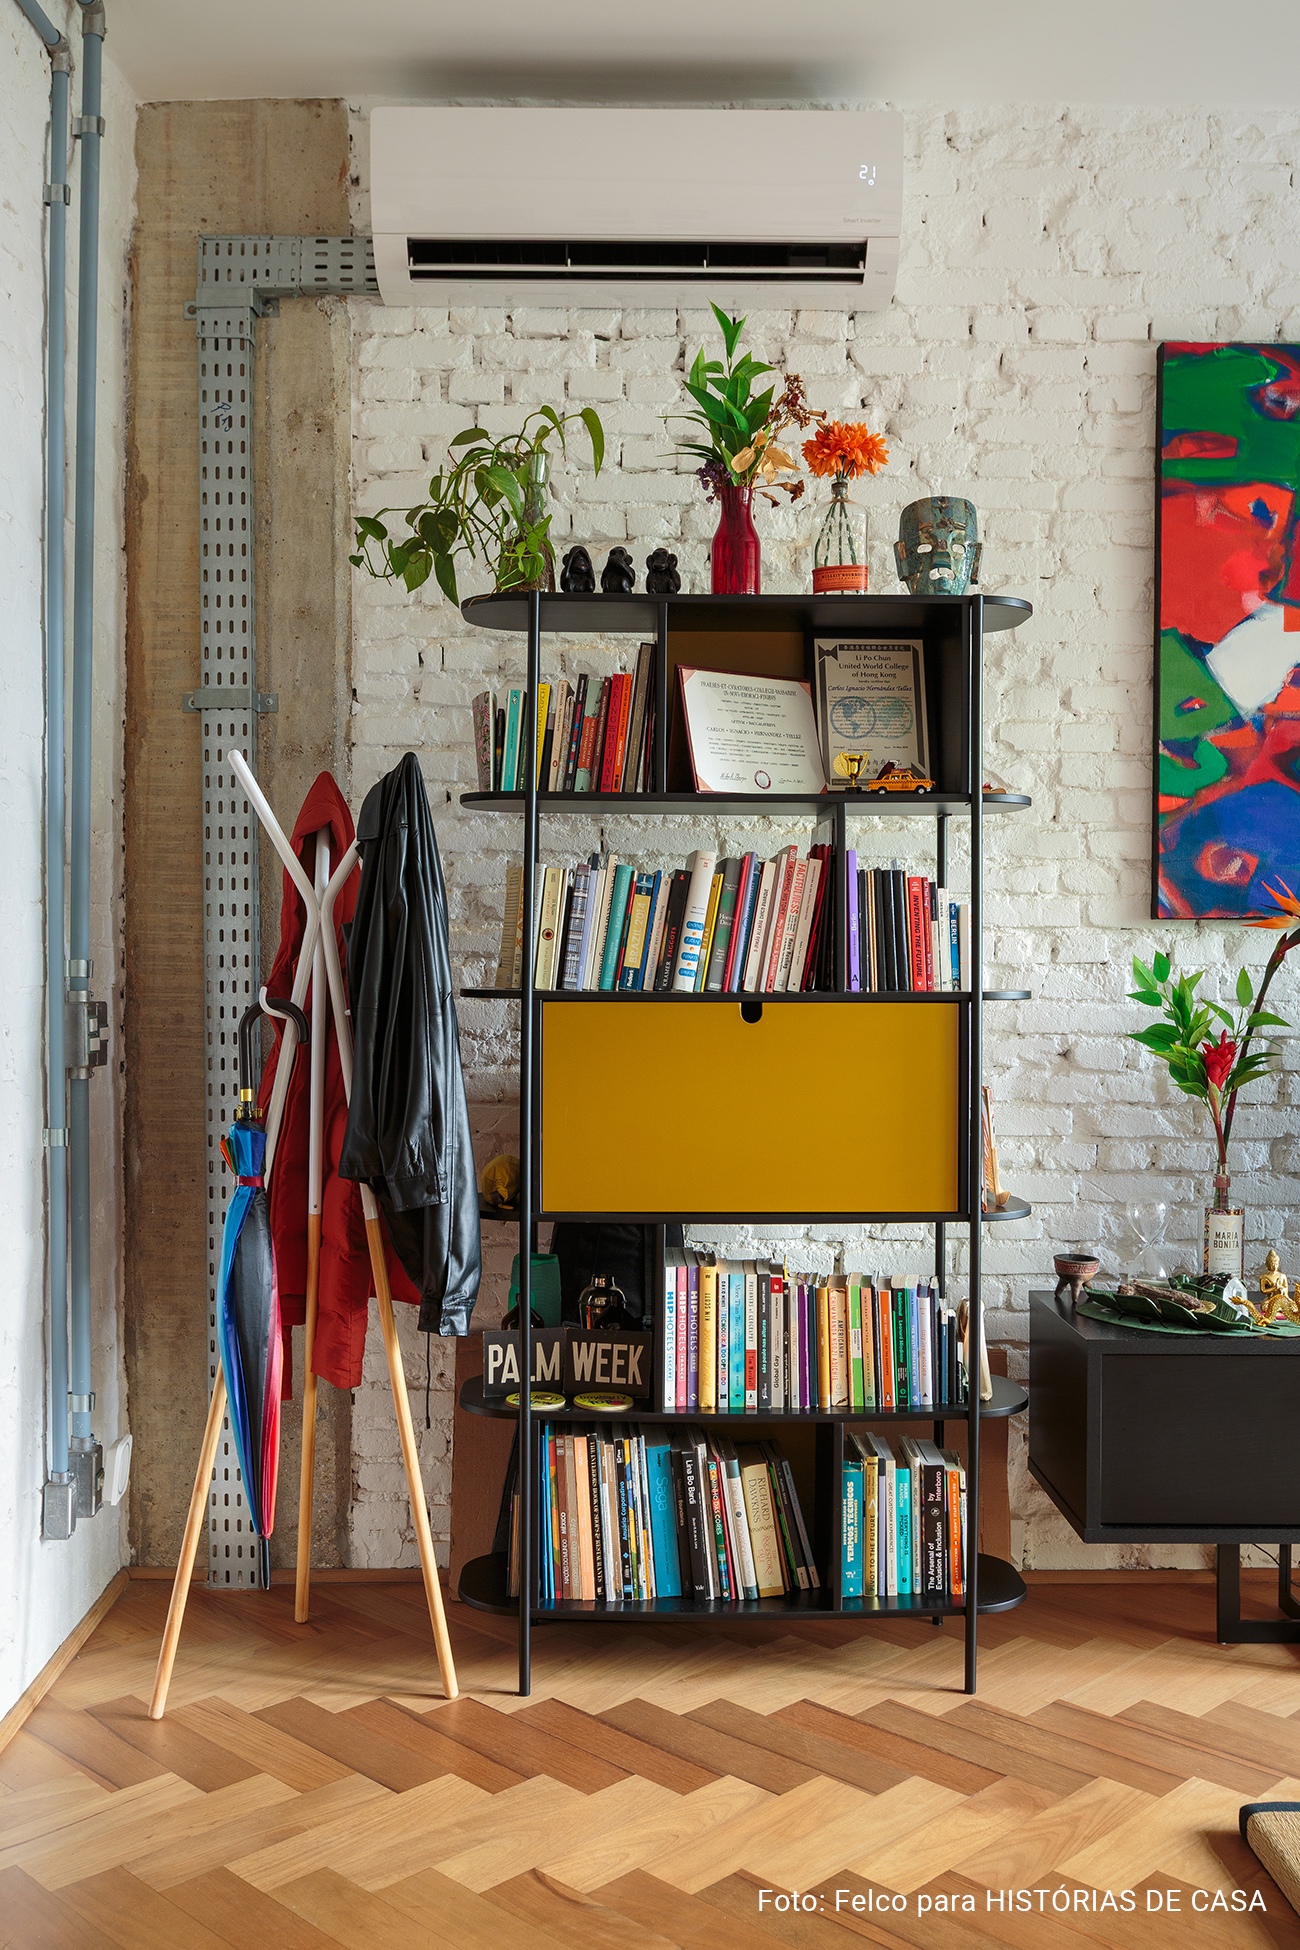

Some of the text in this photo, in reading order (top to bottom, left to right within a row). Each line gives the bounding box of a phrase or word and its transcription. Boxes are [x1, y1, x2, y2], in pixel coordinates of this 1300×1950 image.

[859, 164, 876, 179] 21
[610, 675, 621, 723] MAKING
[754, 730, 782, 738] HERNANDEZ
[604, 733, 616, 782] HEIMAT
[788, 849, 797, 862] QUEER
[618, 874, 627, 902] DESIGNING
[784, 869, 793, 892] GRAPHIC
[790, 864, 806, 914] FACTFULNESS
[781, 893, 789, 915] HISTORY
[629, 903, 646, 963] BRAZIL 2014
[667, 927, 676, 957] FAGGOTS
[783, 951, 792, 969] Rosling
[662, 961, 671, 987] KRAMER
[1214, 1240, 1239, 1248] BONITA
[488, 1341, 644, 1385] PAM WEEK
[687, 1476, 694, 1486] Bo
[655, 1477, 669, 1511] Saga
[688, 1487, 696, 1504] Bardi
[748, 1478, 760, 1523] DAWKINS
[757, 1477, 770, 1521] RICHARD
[928, 1493, 935, 1501] by
[593, 1503, 599, 1512] OF
[762, 1535, 774, 1577] ANCESTOR'S
[870, 1558, 875, 1568] TO
